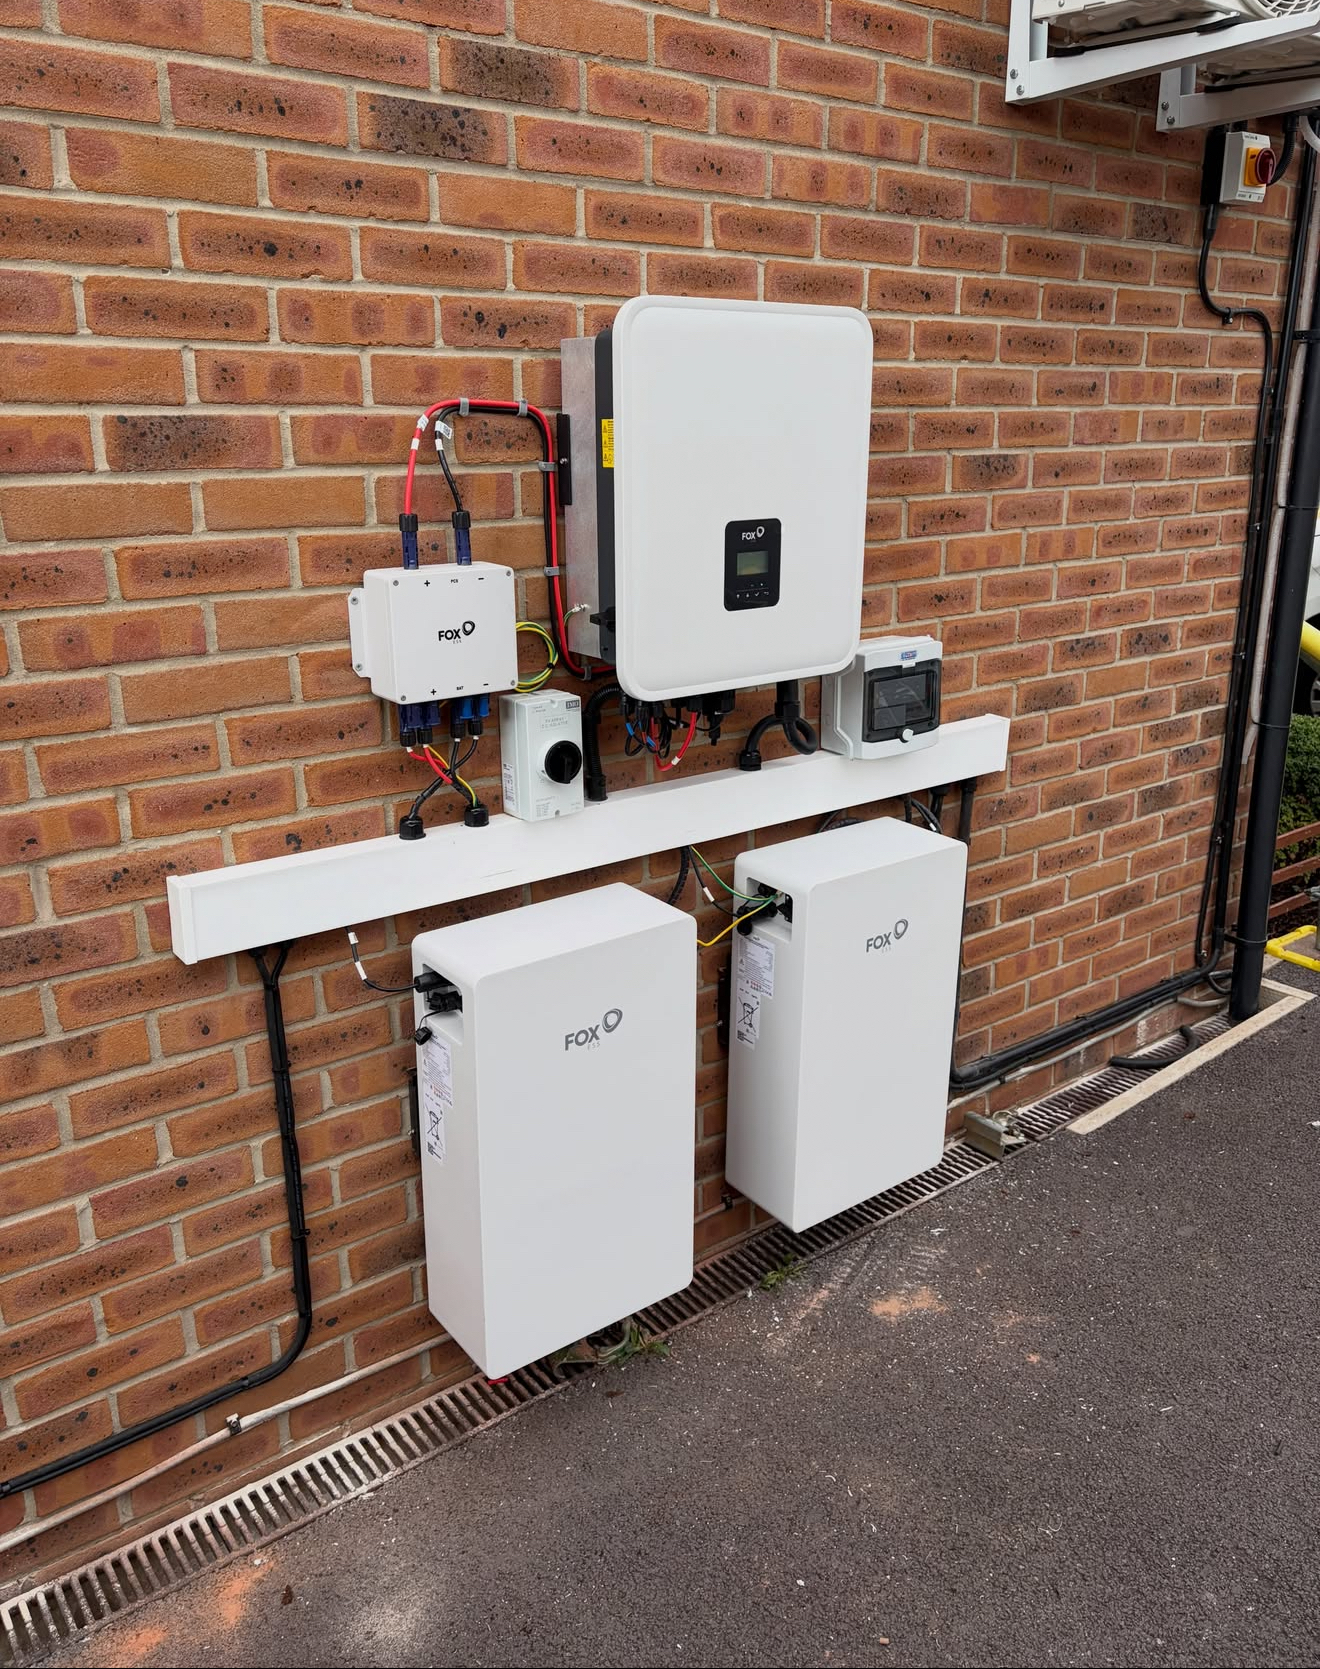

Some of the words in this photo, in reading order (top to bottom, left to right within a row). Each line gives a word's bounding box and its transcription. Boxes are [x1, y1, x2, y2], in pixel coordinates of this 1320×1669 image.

[741, 531, 756, 541] FOX
[438, 628, 461, 641] FOX
[866, 931, 892, 953] FOX
[565, 1023, 600, 1051] FOX
